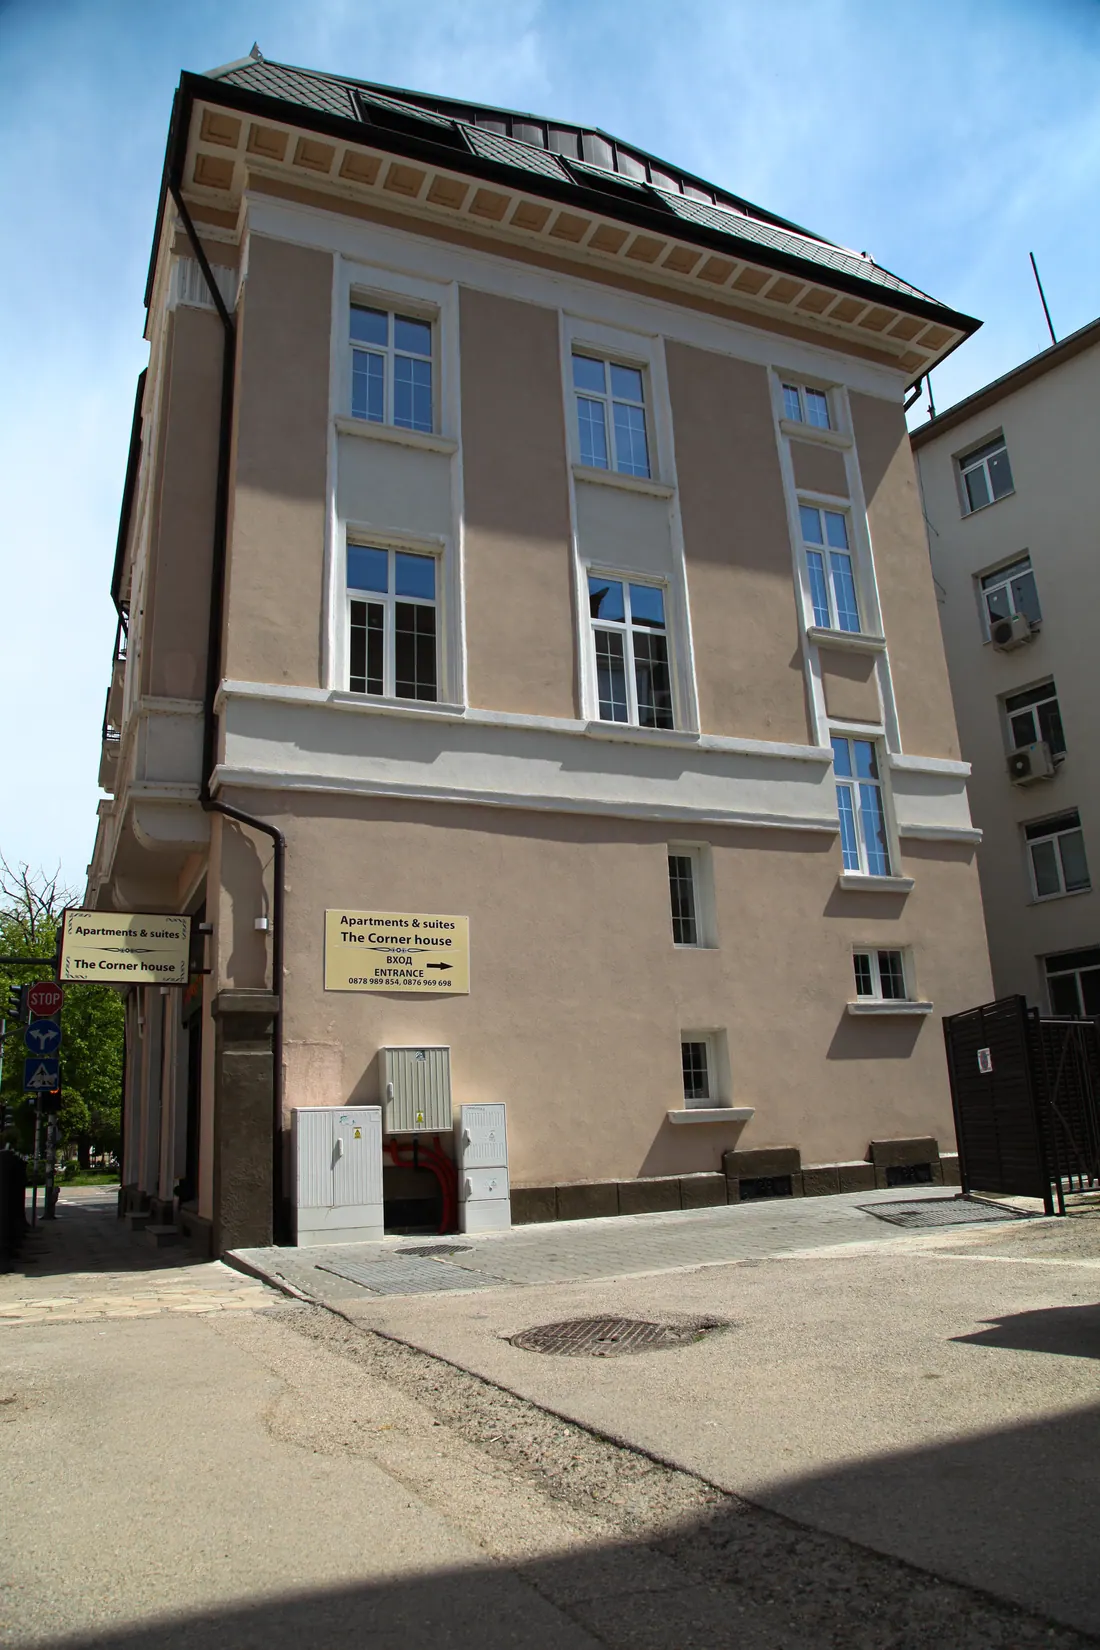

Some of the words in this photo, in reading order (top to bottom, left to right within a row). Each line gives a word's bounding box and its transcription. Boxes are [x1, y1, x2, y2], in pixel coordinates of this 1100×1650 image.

[340, 916, 408, 928] Apartments
[412, 919, 420, 928] &
[423, 920, 455, 930] suites
[75, 926, 137, 937] Apartments
[140, 930, 148, 938] &
[150, 930, 180, 938] suites
[341, 932, 364, 942] The
[368, 933, 411, 944] Corner
[414, 935, 452, 946] house
[74, 960, 96, 969] The
[98, 960, 138, 970] Corner
[140, 962, 176, 972] house
[386, 956, 412, 966] ВХОД
[374, 968, 424, 978] ENTRANCE
[30, 992, 60, 1006] STOP
